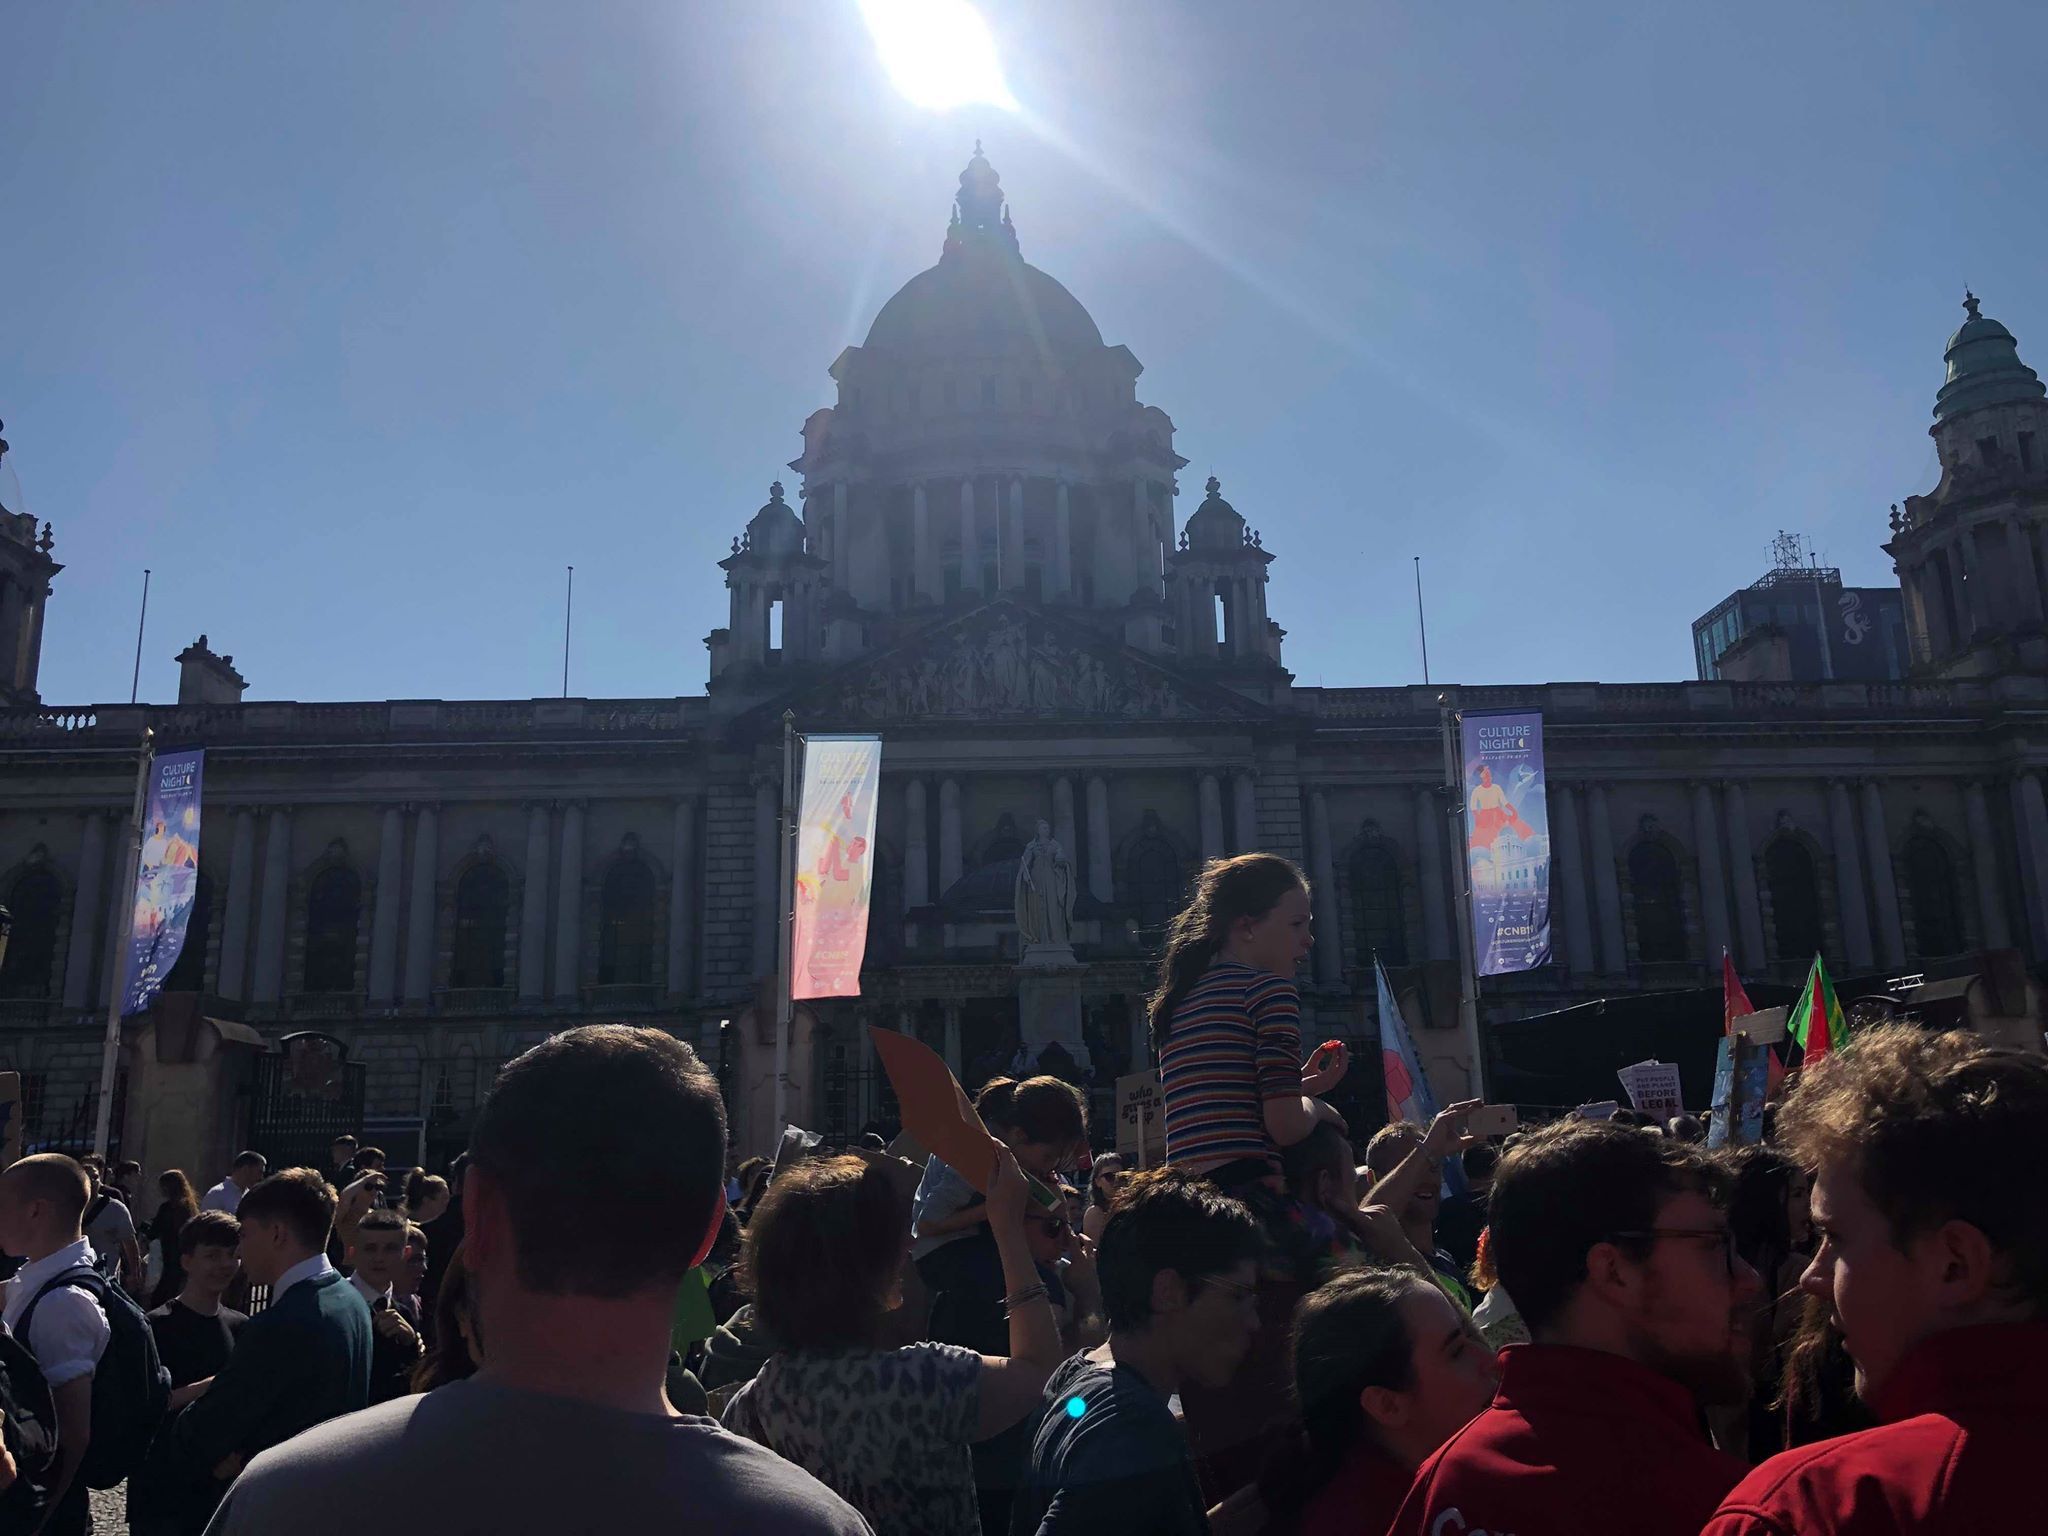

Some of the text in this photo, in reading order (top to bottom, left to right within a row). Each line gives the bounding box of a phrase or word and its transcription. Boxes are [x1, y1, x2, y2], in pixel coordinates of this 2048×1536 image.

[1478, 725, 1531, 738] CULTURE
[1479, 738, 1517, 750] NIGHT
[162, 761, 196, 776] CULTURE
[160, 775, 186, 788] NIGHT
[1129, 1085, 1153, 1101] who
[1637, 1088, 1677, 1099] BEFORE
